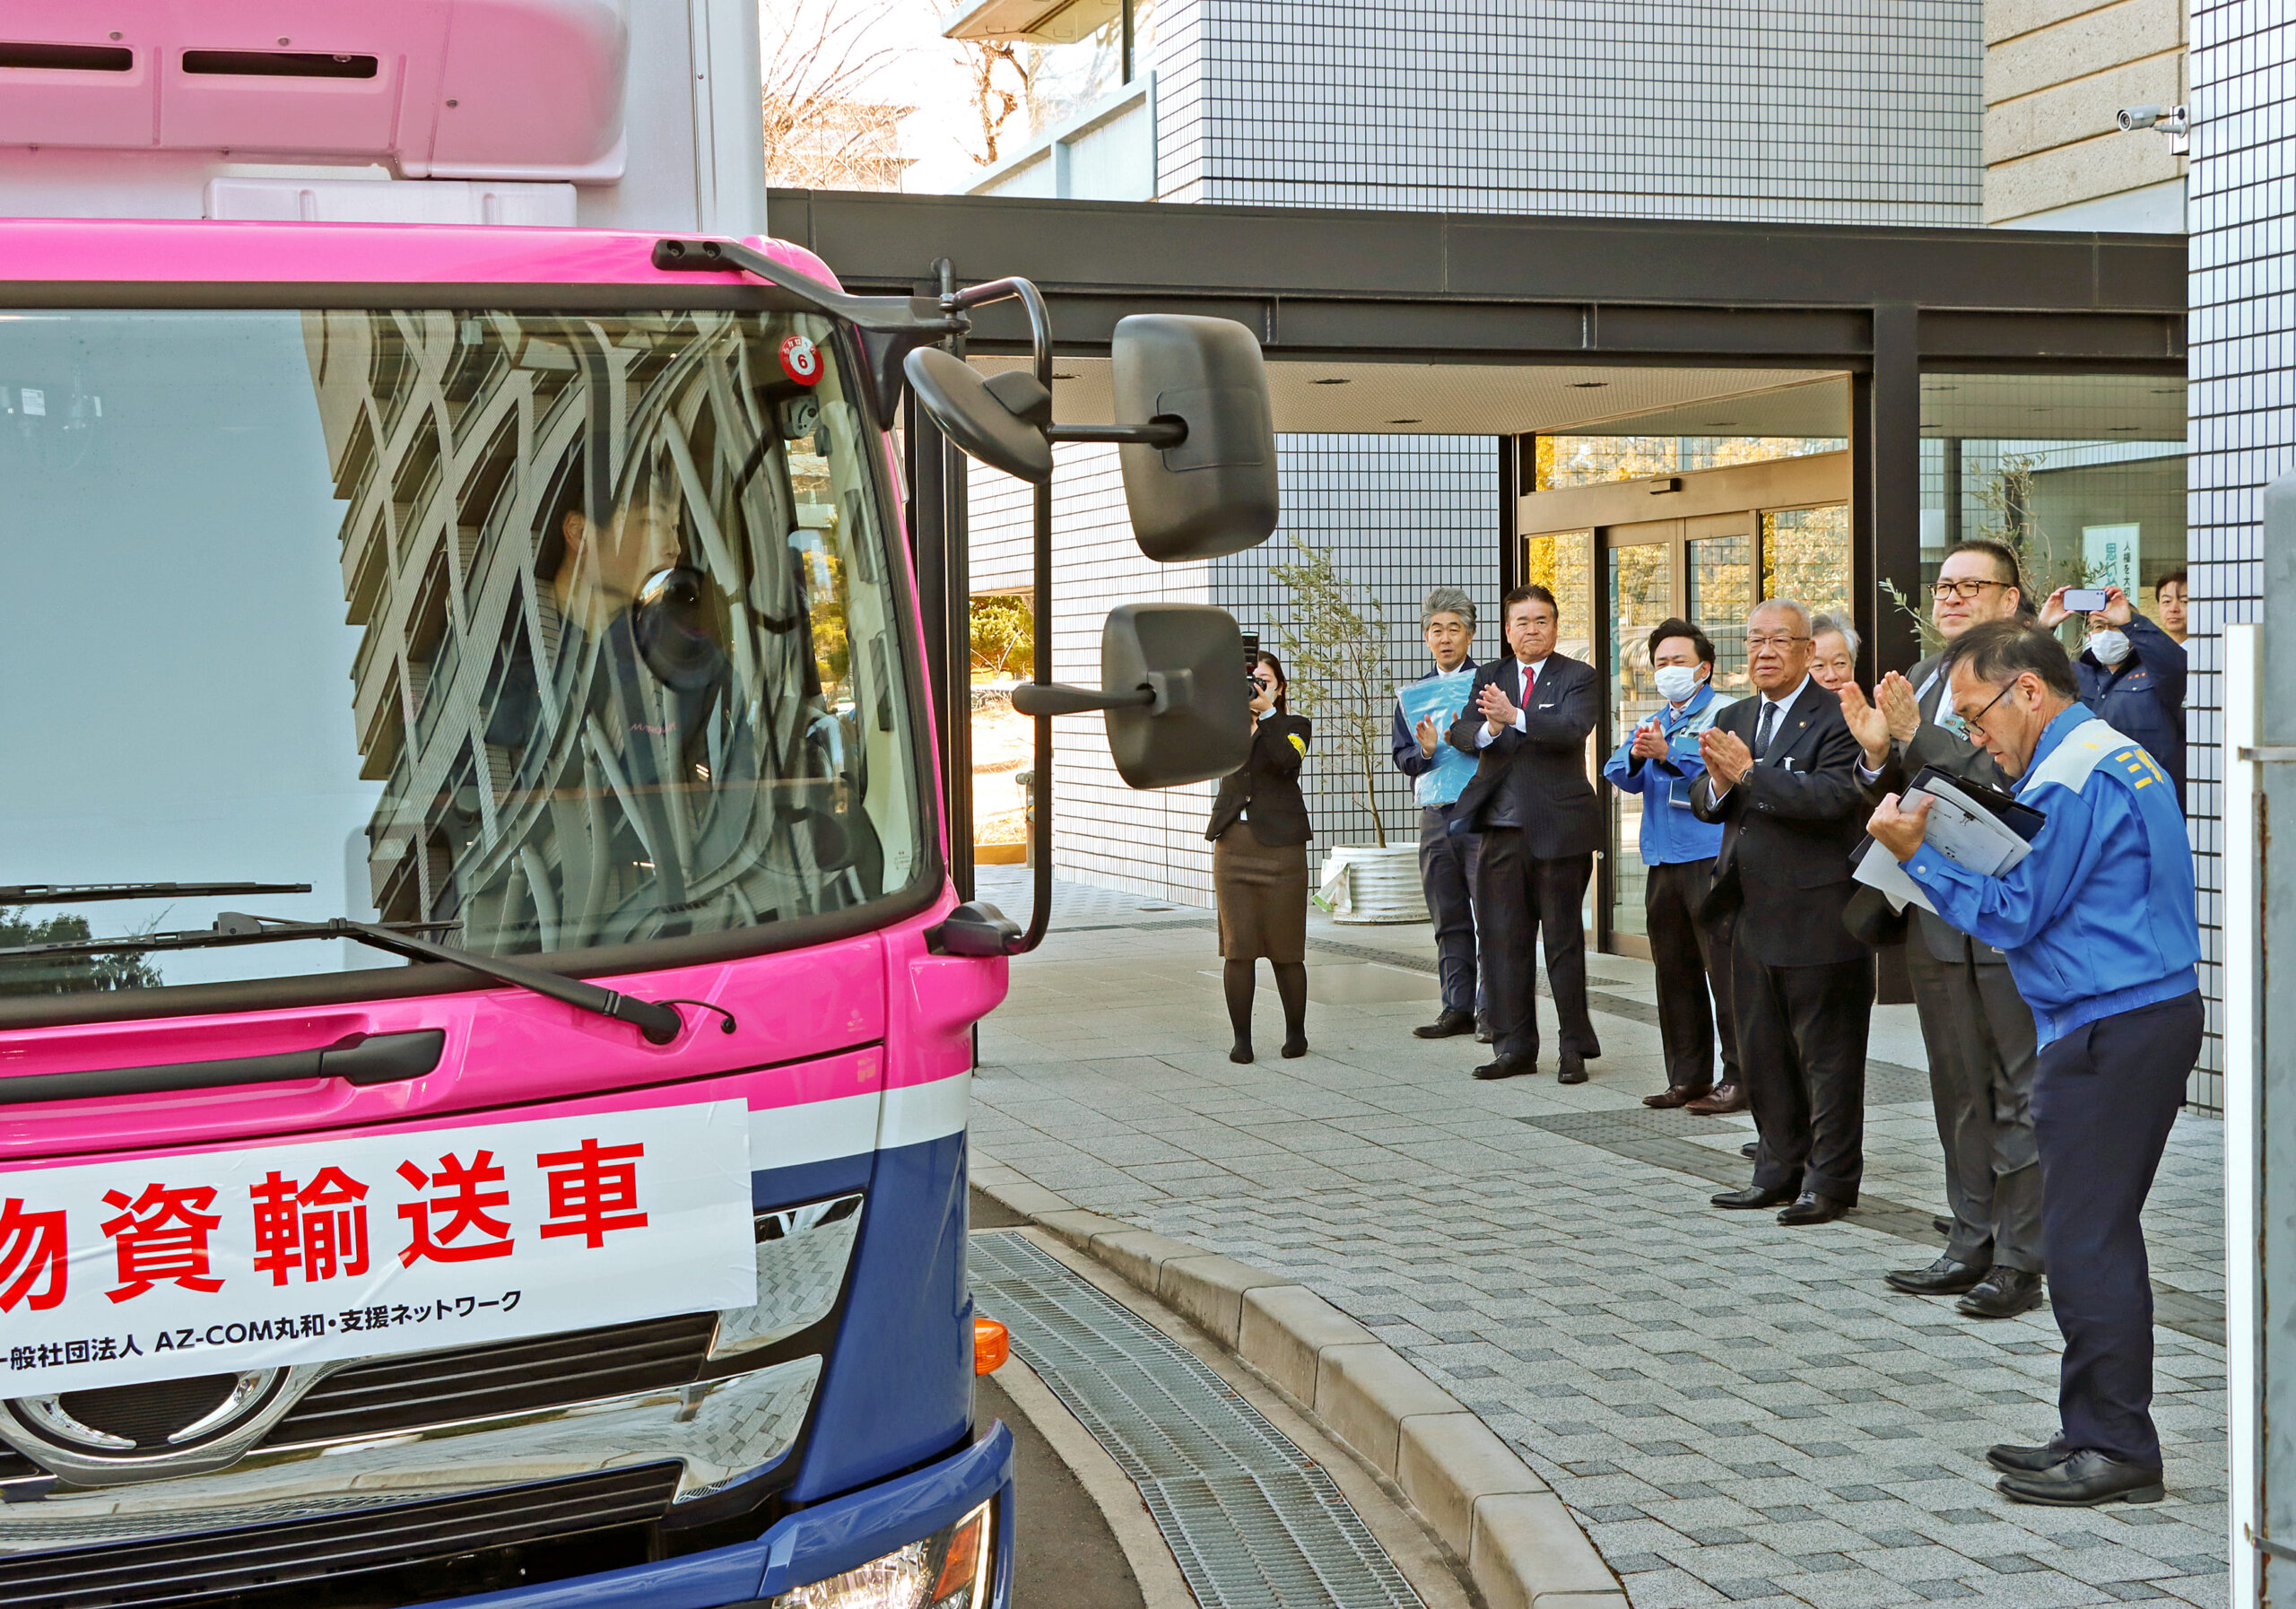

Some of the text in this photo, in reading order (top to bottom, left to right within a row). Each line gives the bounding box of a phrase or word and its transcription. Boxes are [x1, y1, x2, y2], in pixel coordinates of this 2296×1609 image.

[797, 354, 807, 369] 6
[154, 1290, 522, 1352] AZ-COM丸和・支援ネットワーク
